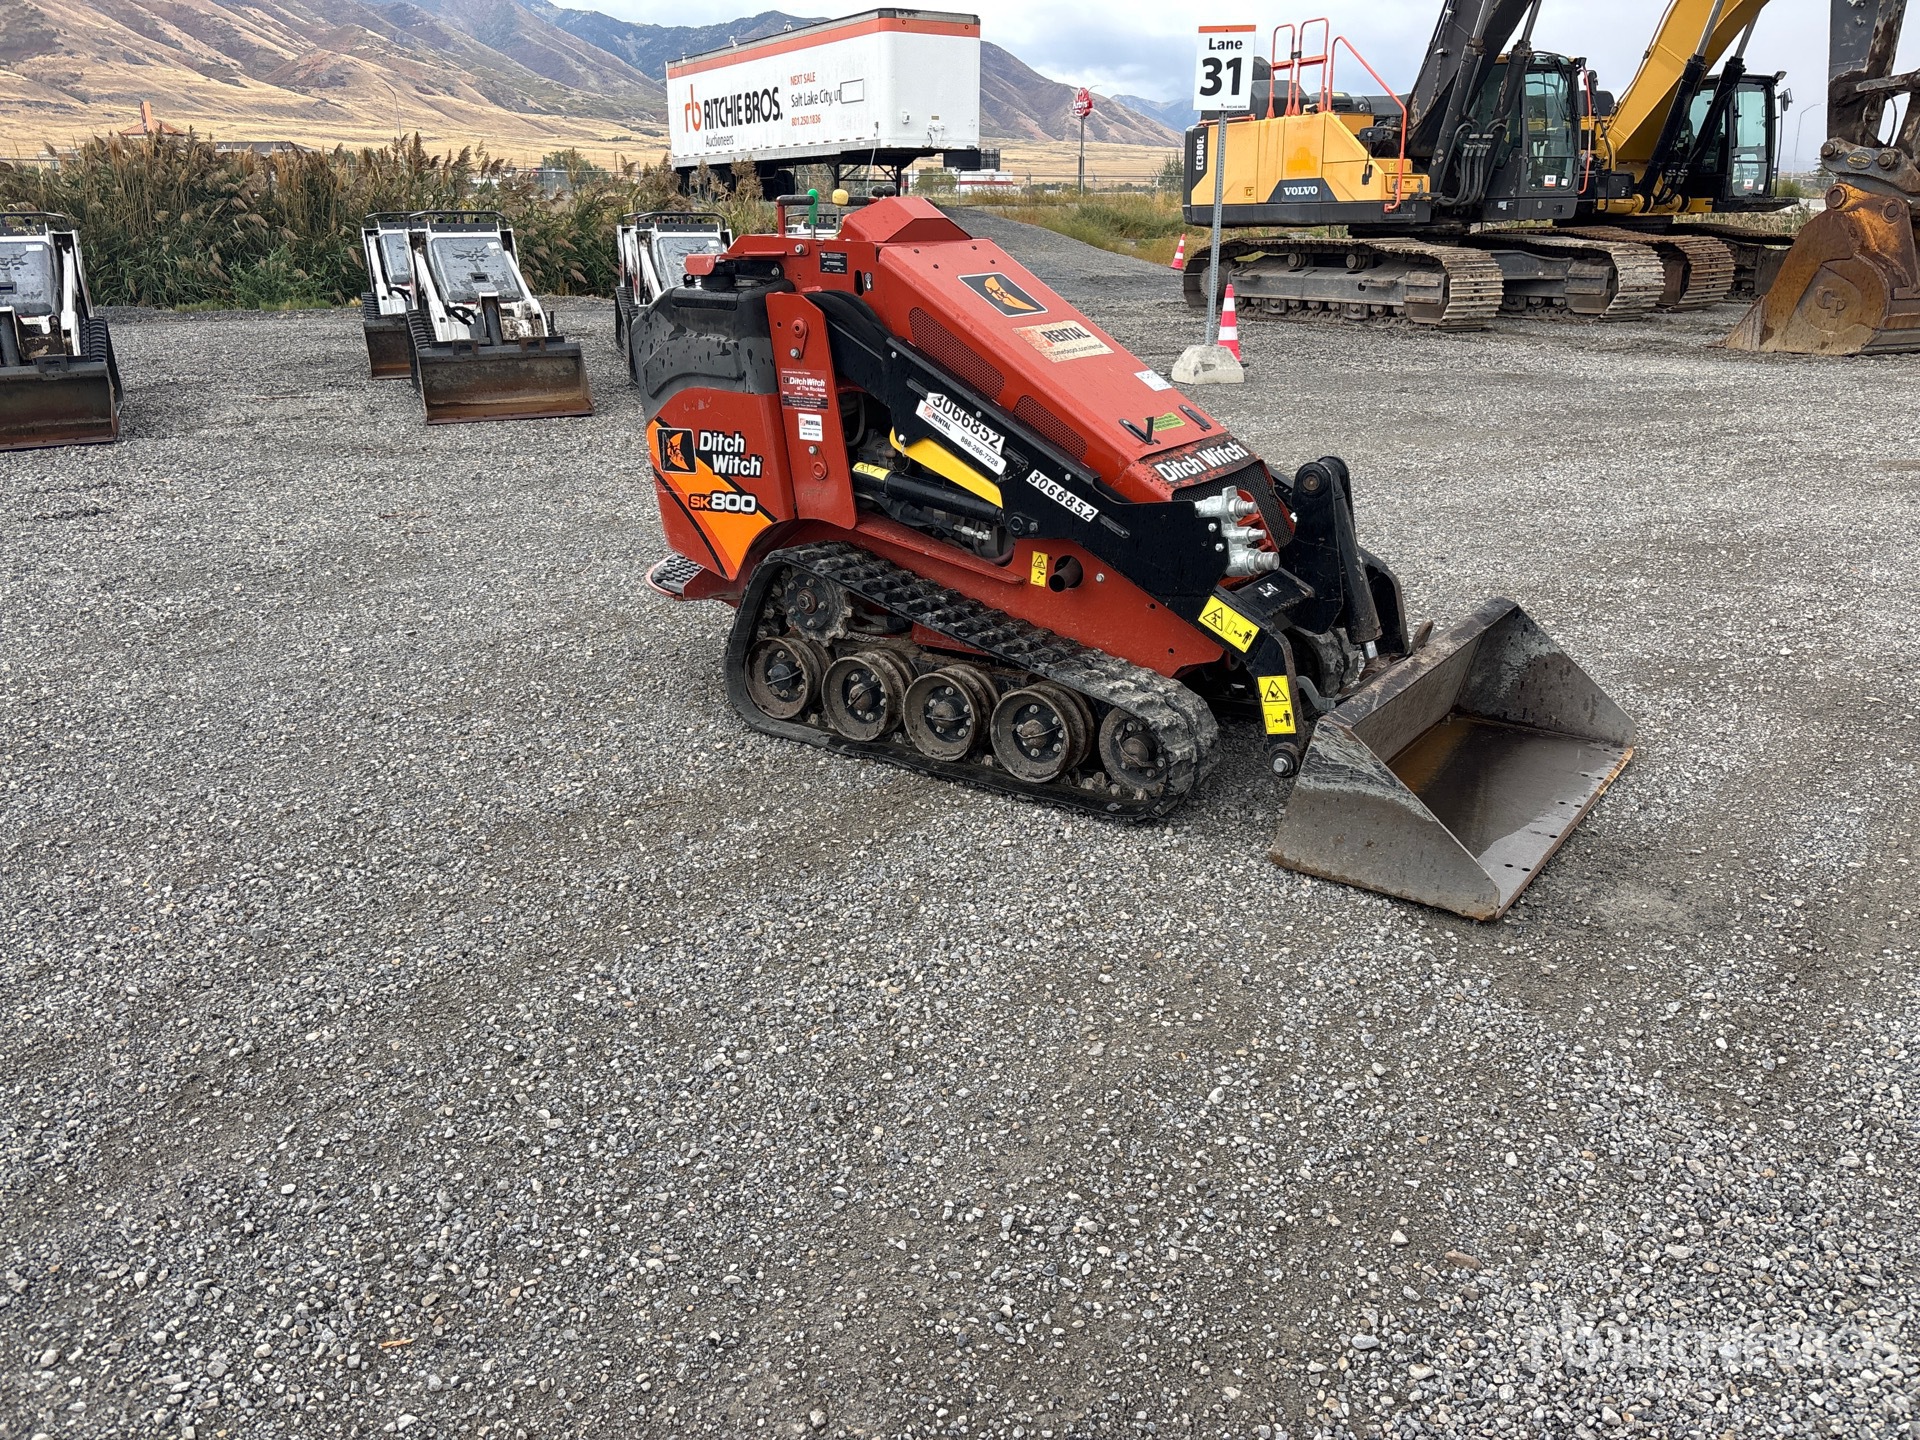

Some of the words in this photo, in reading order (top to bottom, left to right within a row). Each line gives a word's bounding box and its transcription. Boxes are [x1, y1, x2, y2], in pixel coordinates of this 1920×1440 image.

[1208, 37, 1243, 50] Lane
[790, 73, 803, 86] NEXT
[803, 71, 816, 84] SALE
[1199, 57, 1242, 96] 31
[684, 83, 701, 133] rb
[704, 93, 743, 131] RITCHIE
[744, 86, 783, 125] BROS.
[790, 91, 803, 108] Salt
[803, 90, 819, 106] Lake
[819, 88, 833, 107] City,
[791, 114, 822, 127] 801.250.1836
[705, 132, 734, 148] Auctioneers
[1283, 186, 1318, 195] VOLVO
[1040, 326, 1091, 343] RENTAL
[789, 376, 806, 385] Ditch
[931, 411, 951, 431] RENTAL
[932, 395, 1003, 450] 3066852
[699, 432, 745, 453] Ditch
[960, 436, 999, 467] 888-266-7228
[713, 454, 762, 476] Witch
[1154, 455, 1207, 482] Ditch
[1196, 441, 1249, 468] Witch
[689, 493, 756, 513] SK800
[1029, 473, 1095, 522] 3066852
